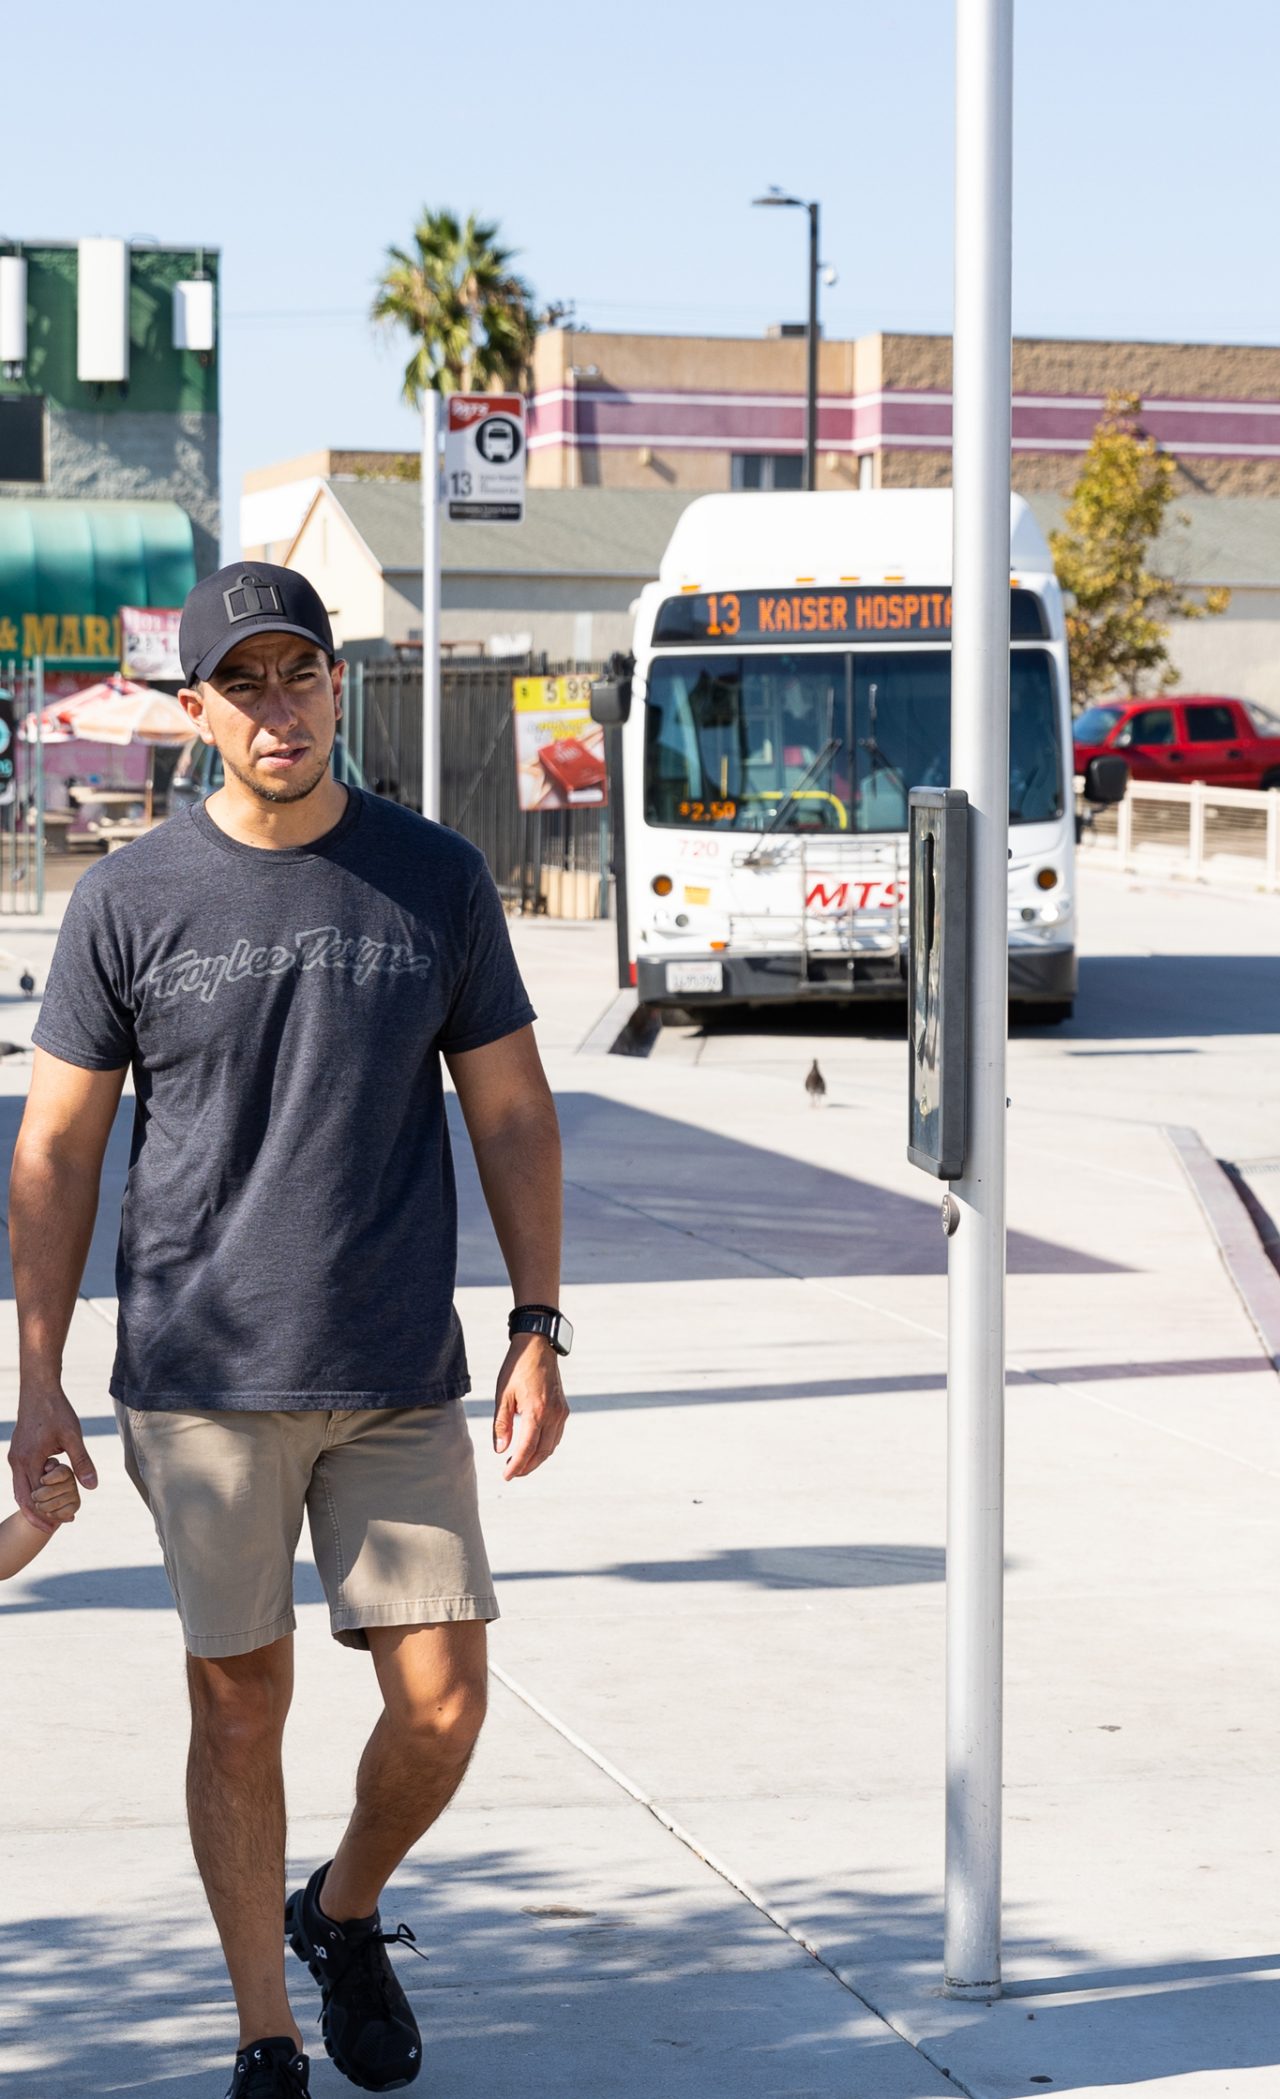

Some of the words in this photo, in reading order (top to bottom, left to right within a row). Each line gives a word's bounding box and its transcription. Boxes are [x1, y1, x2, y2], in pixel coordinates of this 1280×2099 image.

[451, 471, 472, 497] 13
[707, 594, 740, 635] 13
[759, 596, 848, 631] KAISER
[0, 616, 18, 650] &
[22, 613, 121, 658] MAR
[679, 839, 720, 857] 720
[805, 881, 907, 909] MTS
[149, 949, 229, 1003] Troy
[223, 938, 296, 983] Lee
